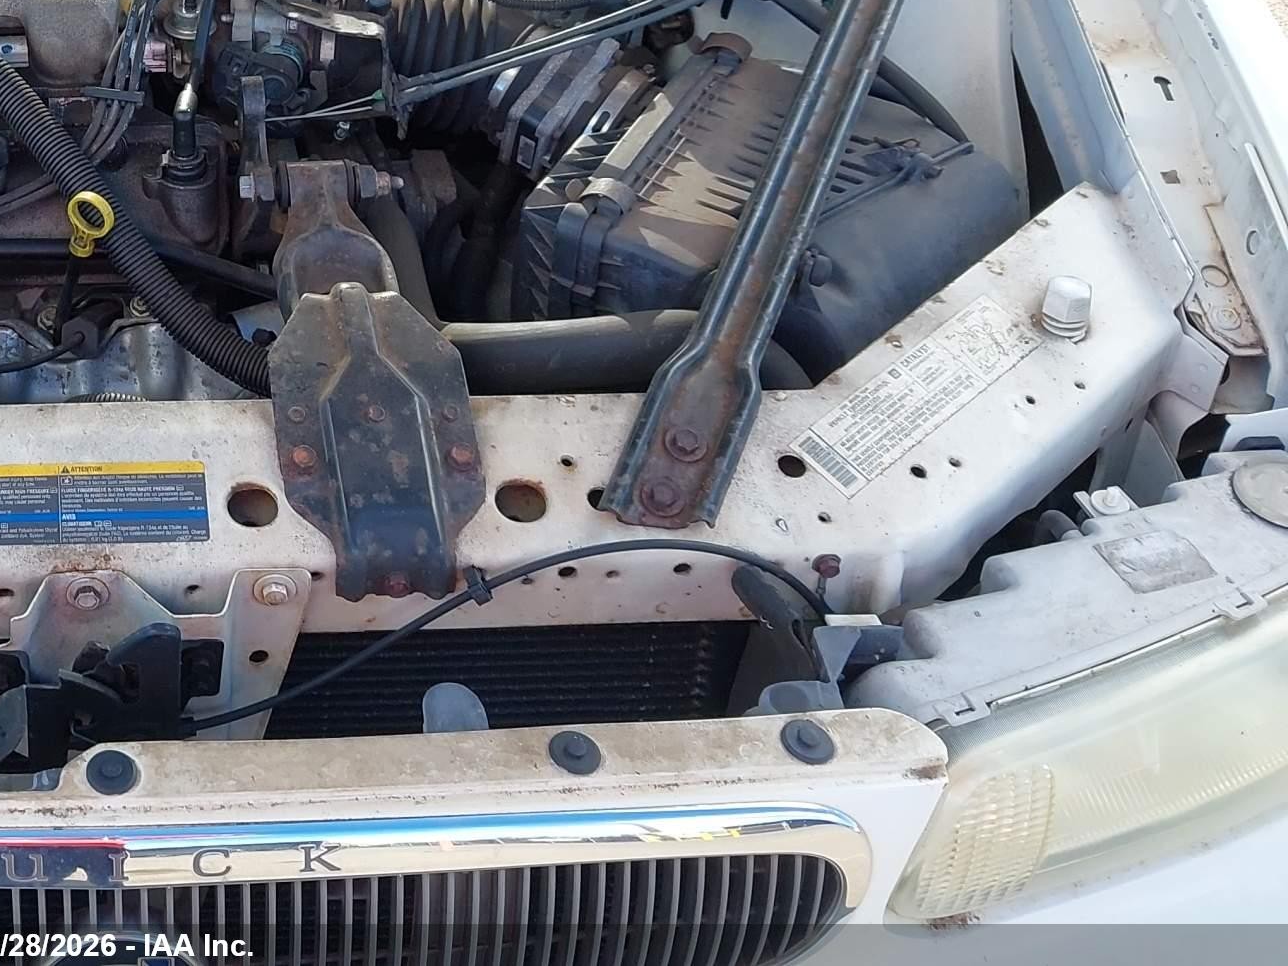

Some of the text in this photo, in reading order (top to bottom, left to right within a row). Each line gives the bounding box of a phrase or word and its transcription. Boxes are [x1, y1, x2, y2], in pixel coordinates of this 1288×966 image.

[901, 344, 931, 368] CATALYST
[70, 465, 103, 473] ATTENTION
[61, 513, 76, 521] AVIS
